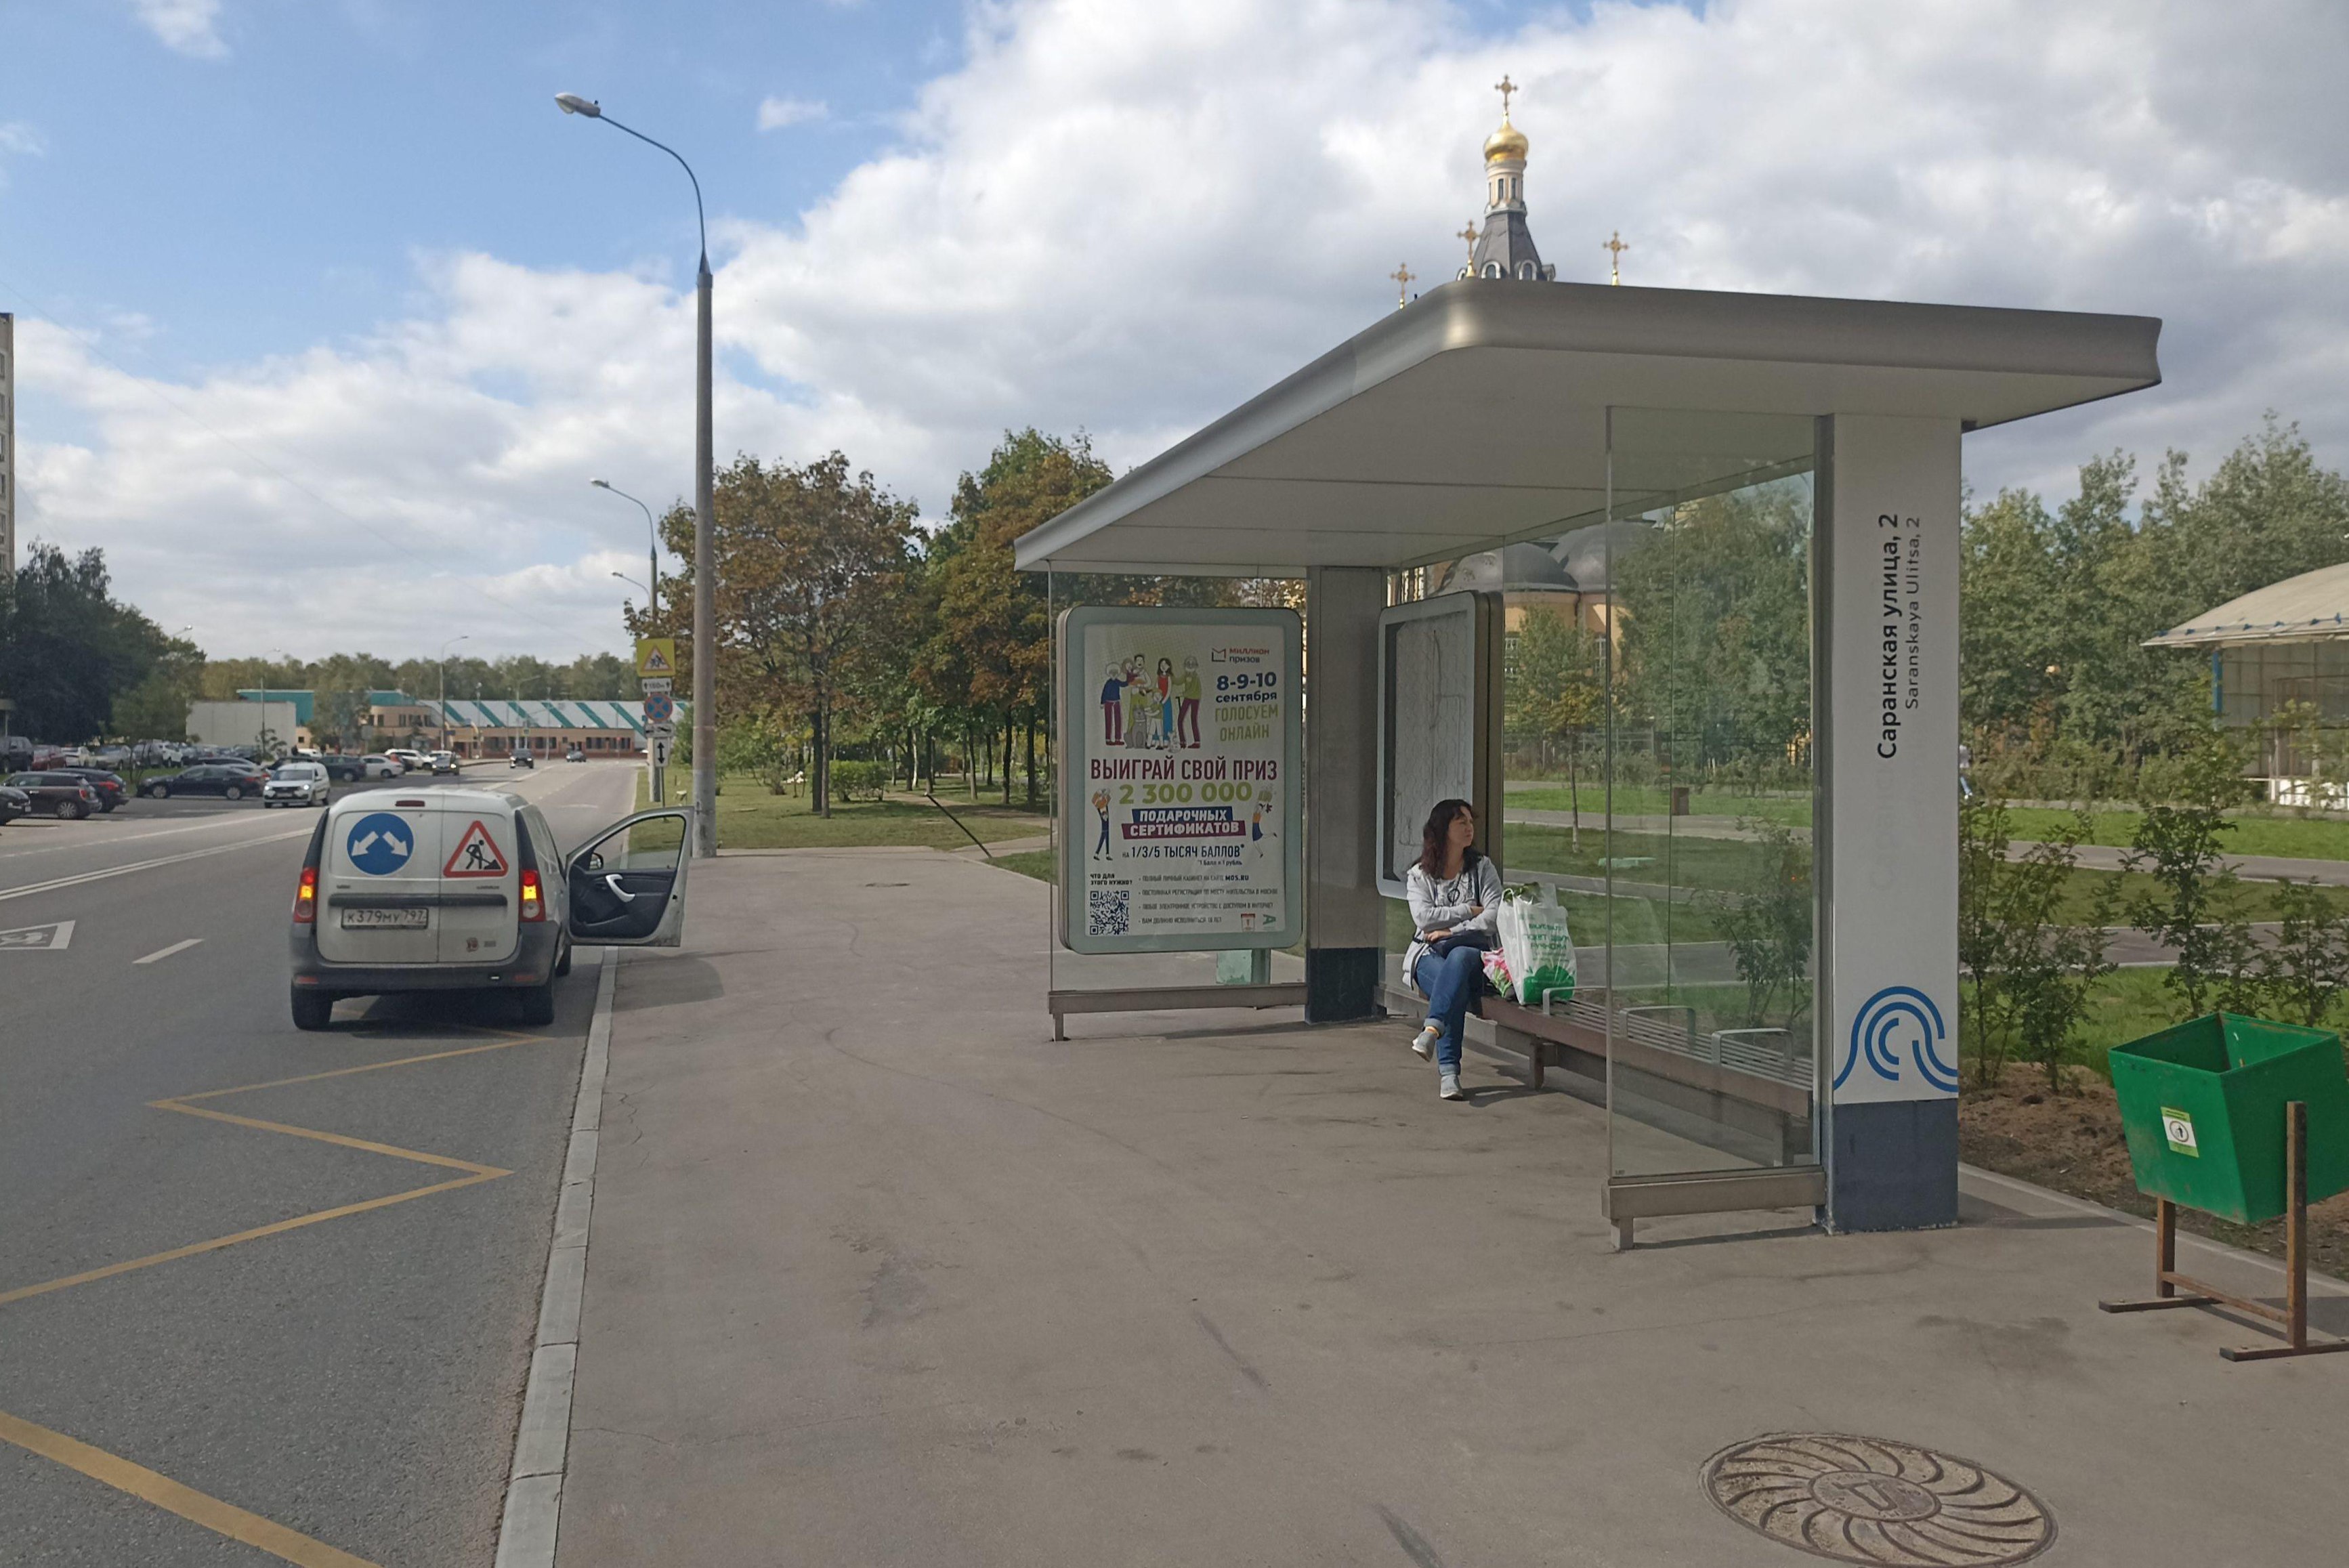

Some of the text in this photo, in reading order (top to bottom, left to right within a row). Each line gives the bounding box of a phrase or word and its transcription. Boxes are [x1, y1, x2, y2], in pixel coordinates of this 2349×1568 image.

[1905, 517, 1922, 709] Saranskaya Ulitsa, 2
[1878, 513, 1902, 759] Саранская улица, 2
[1216, 671, 1277, 691] 8-9-10
[1216, 690, 1277, 703] сентября
[1215, 704, 1278, 722] ГОЛОСУЕМ
[1219, 723, 1269, 741] ОНЛАЙН
[1091, 756, 1277, 781] ВЫИГРАЙ СВОЙ ПРИЗ
[1119, 782, 1252, 805] 2 300 000
[1139, 809, 1227, 824] ПОДАРОЧНЫХ
[1129, 822, 1239, 836] СЕРТИФИКАТОВ
[1131, 845, 1160, 858] 1/3/5
[1164, 845, 1198, 858] ТЫСЯЧ
[347, 910, 424, 923] К379МУ 797
